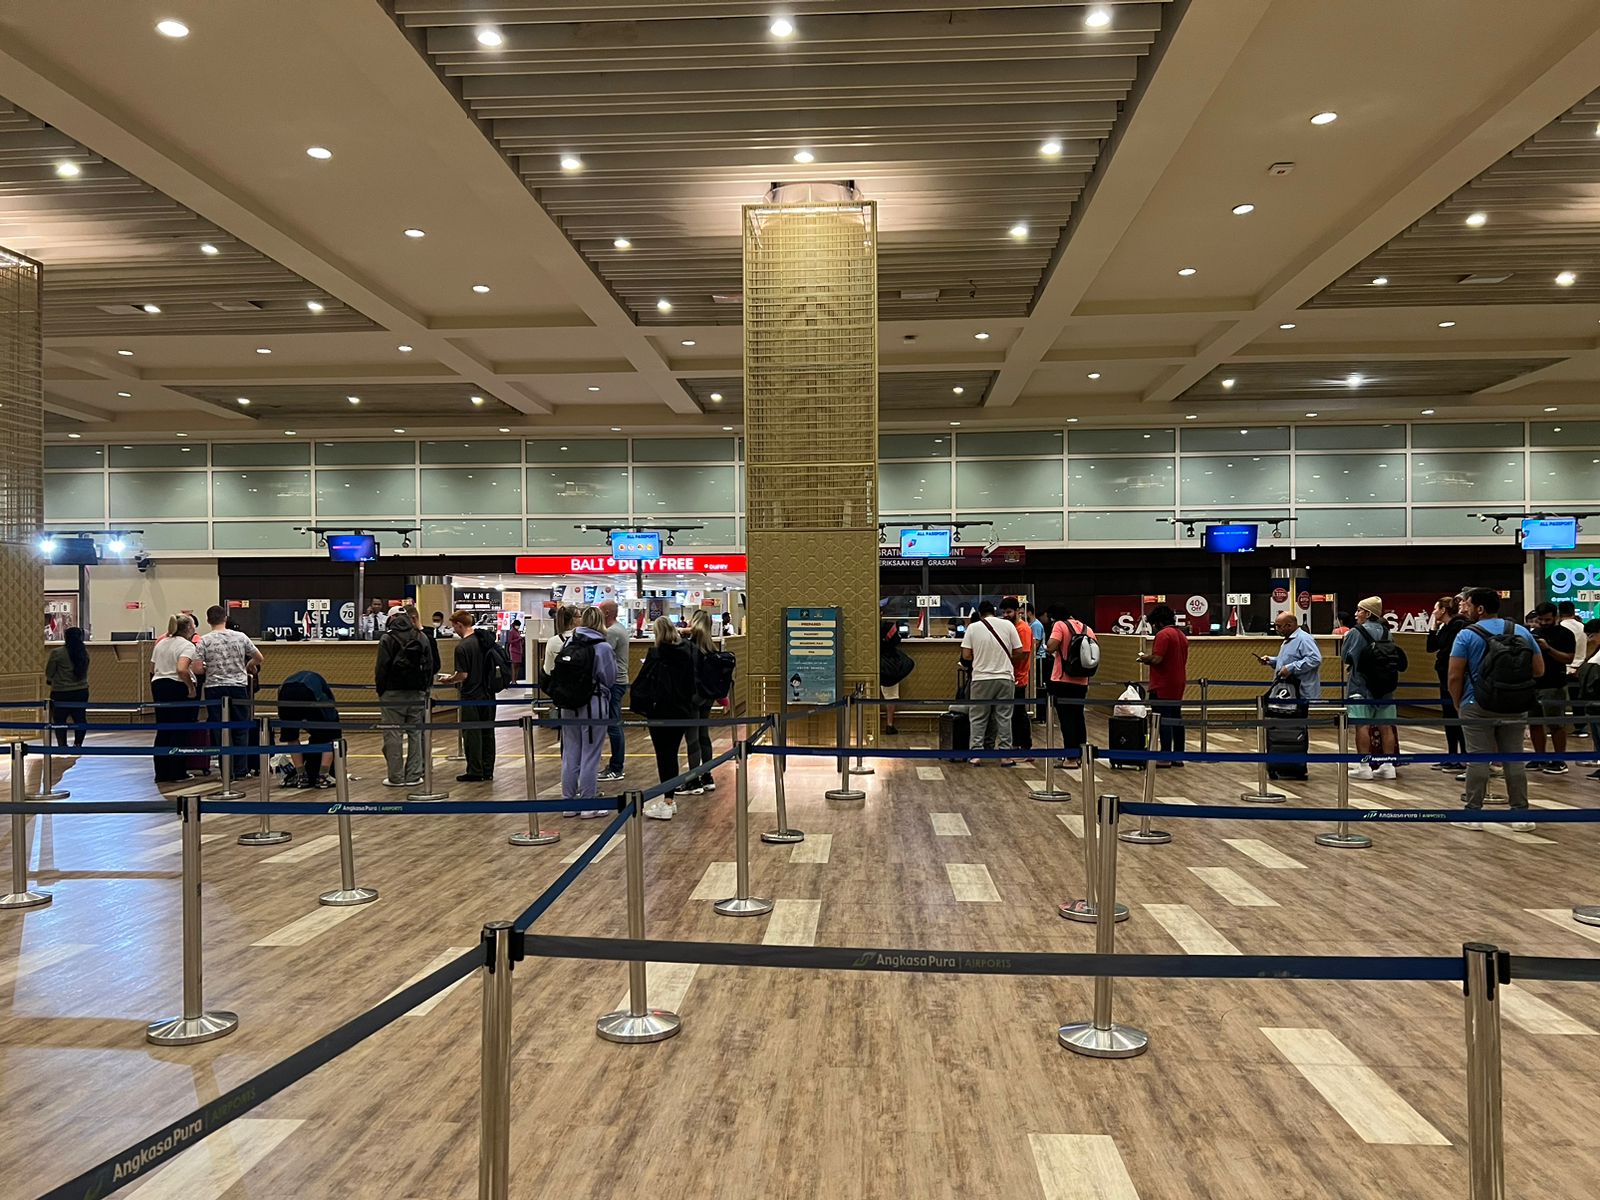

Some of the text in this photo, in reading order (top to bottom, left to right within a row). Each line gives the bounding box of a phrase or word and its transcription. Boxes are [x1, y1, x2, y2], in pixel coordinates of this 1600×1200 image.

[571, 558, 604, 570] BALI
[659, 558, 694, 570] FREE
[965, 958, 1012, 968] AIRPORTS
